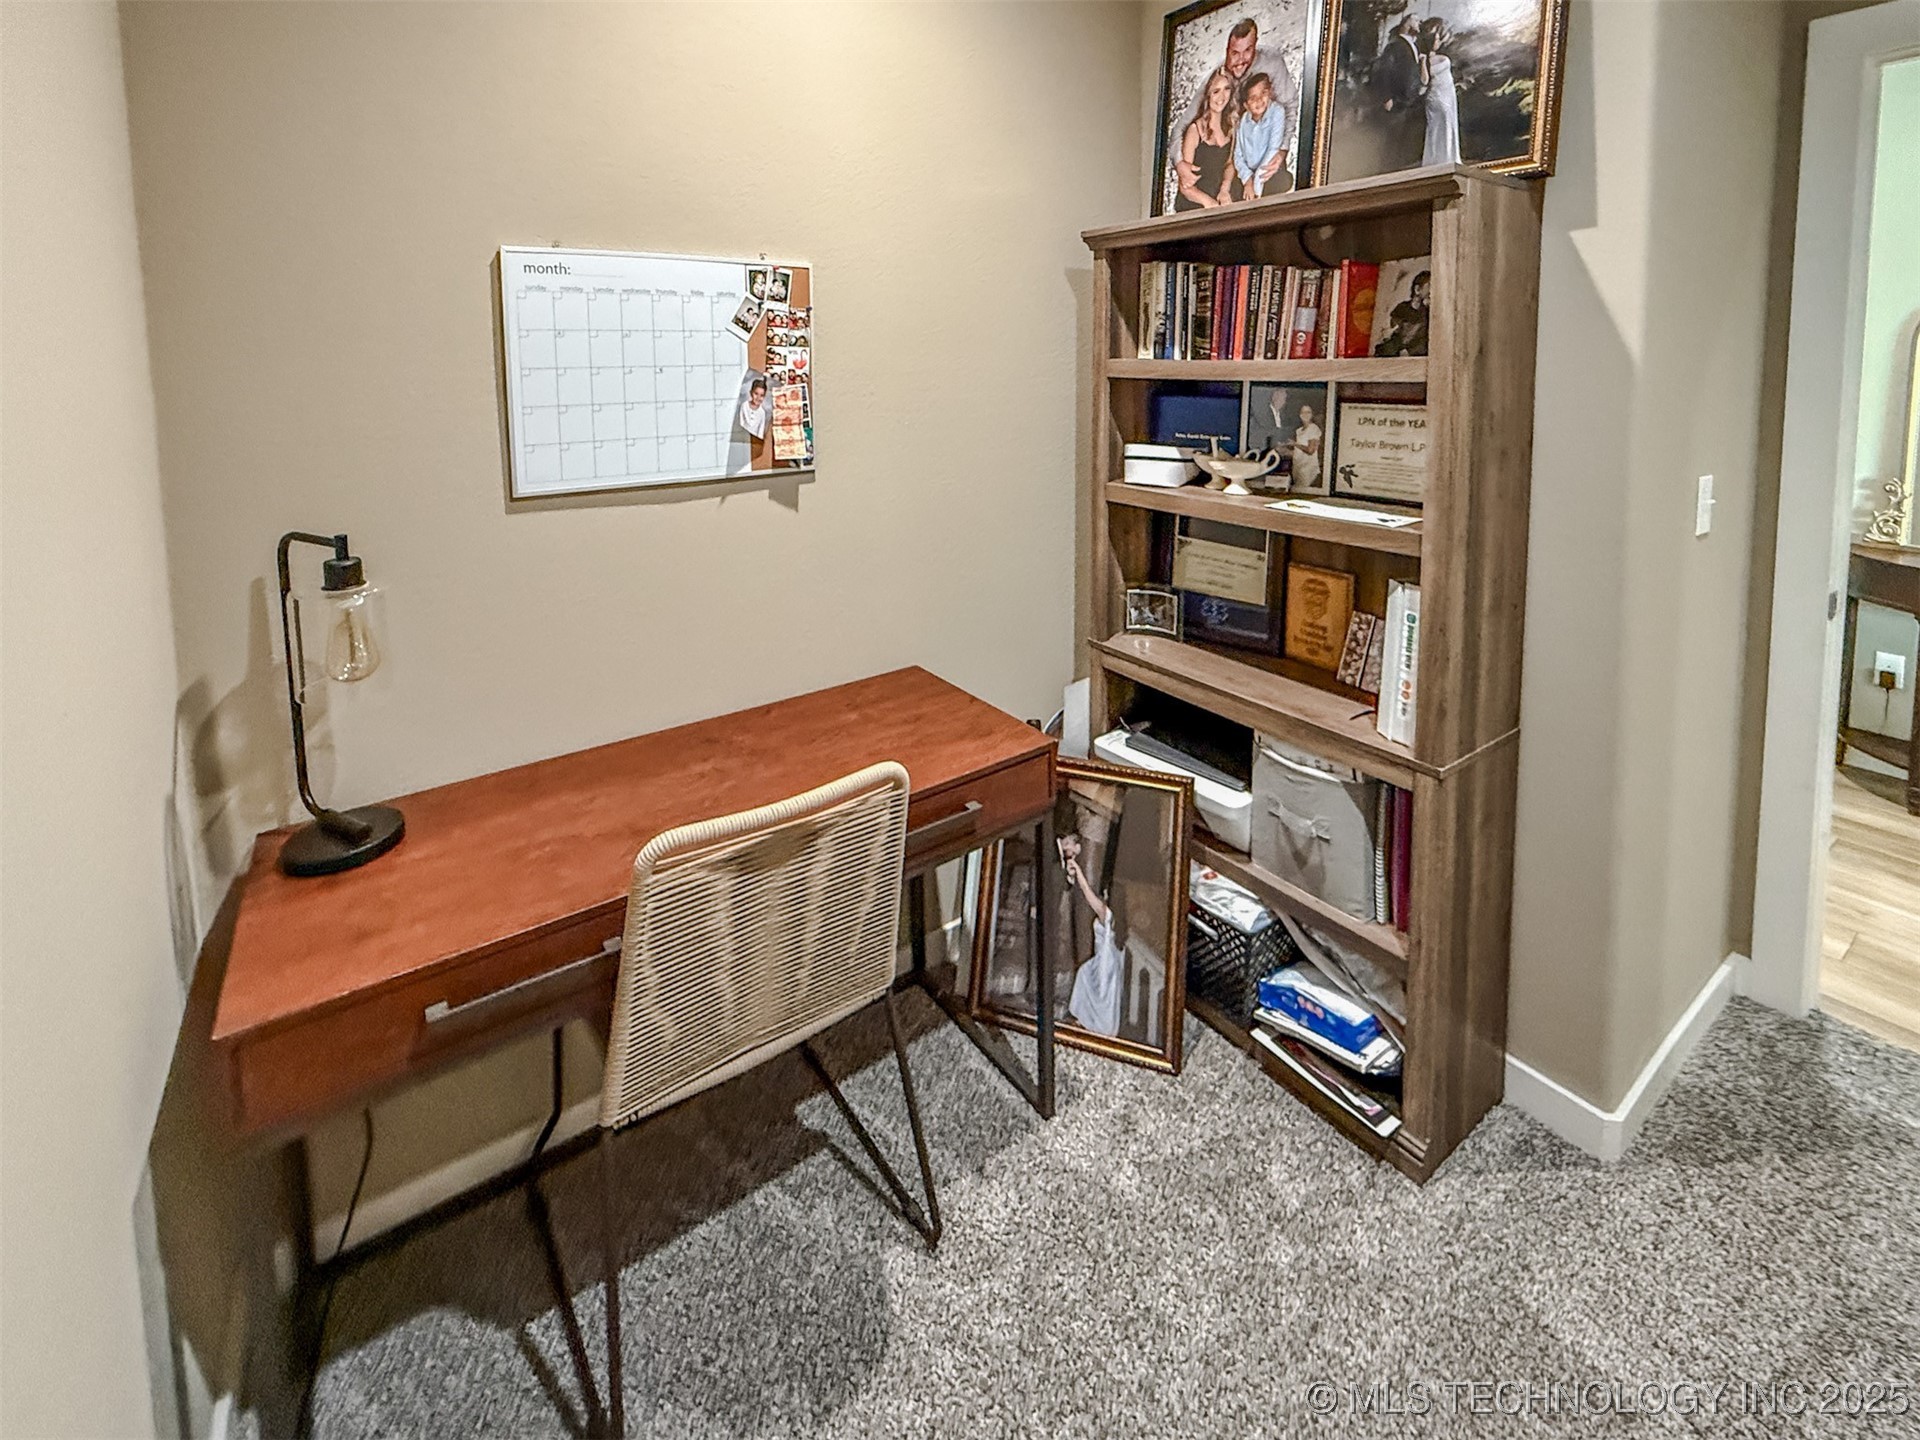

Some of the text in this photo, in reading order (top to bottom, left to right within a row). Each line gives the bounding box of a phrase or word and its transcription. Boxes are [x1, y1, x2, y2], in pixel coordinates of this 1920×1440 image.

[523, 262, 571, 276] month:
[1377, 417, 1387, 426] of
[1389, 418, 1405, 427] the
[1408, 419, 1426, 428] YEA
[1351, 438, 1375, 449] Taylor
[1379, 440, 1408, 450] Brown
